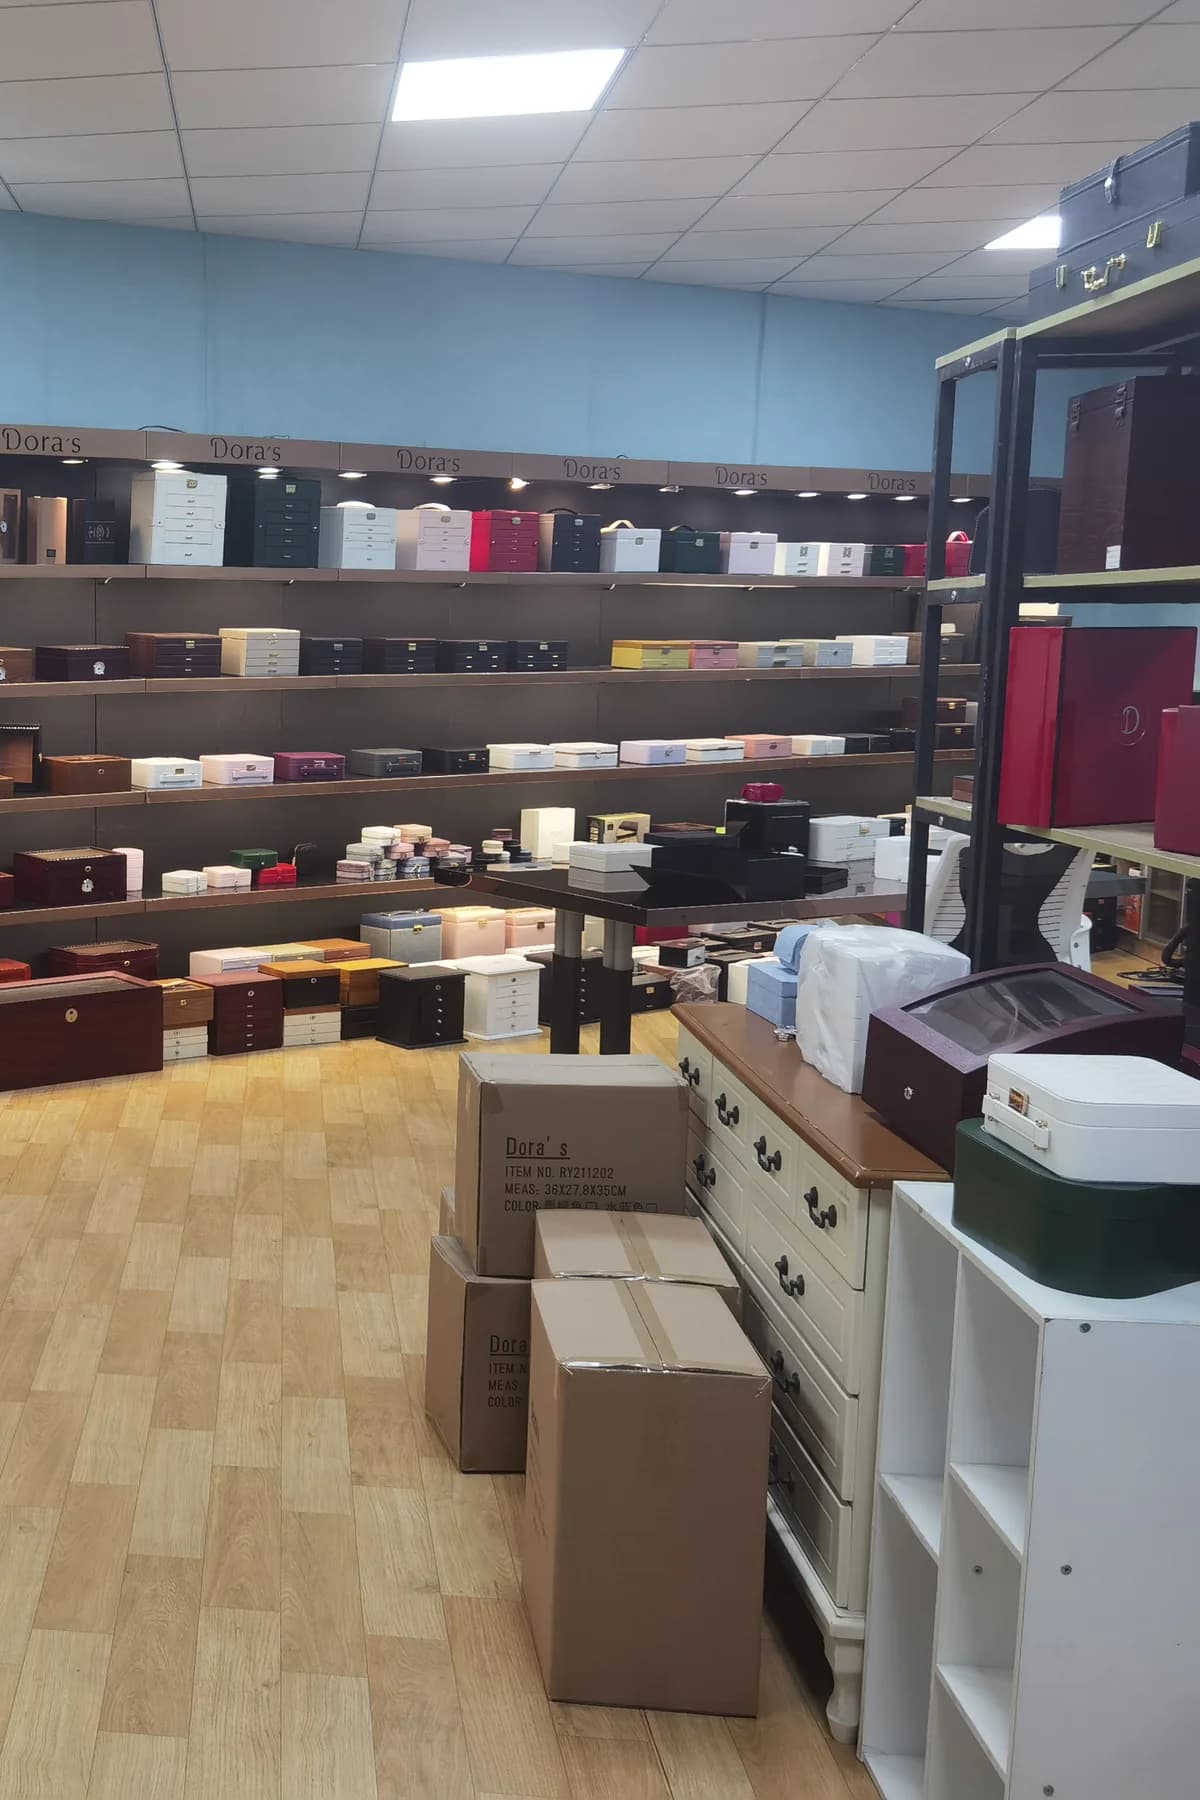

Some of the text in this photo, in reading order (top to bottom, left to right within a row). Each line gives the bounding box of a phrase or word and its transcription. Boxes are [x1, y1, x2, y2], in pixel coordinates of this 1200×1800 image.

[2, 428, 81, 454] Dora's
[211, 437, 281, 462] Dora's
[397, 448, 461, 473] Dora's
[563, 459, 621, 481] Dora's
[715, 466, 768, 486] Dora's
[868, 472, 916, 491] Dora's
[504, 1166, 532, 1177] ITEM
[560, 1167, 614, 1179] RY211202
[488, 1363, 514, 1375] ITEM
